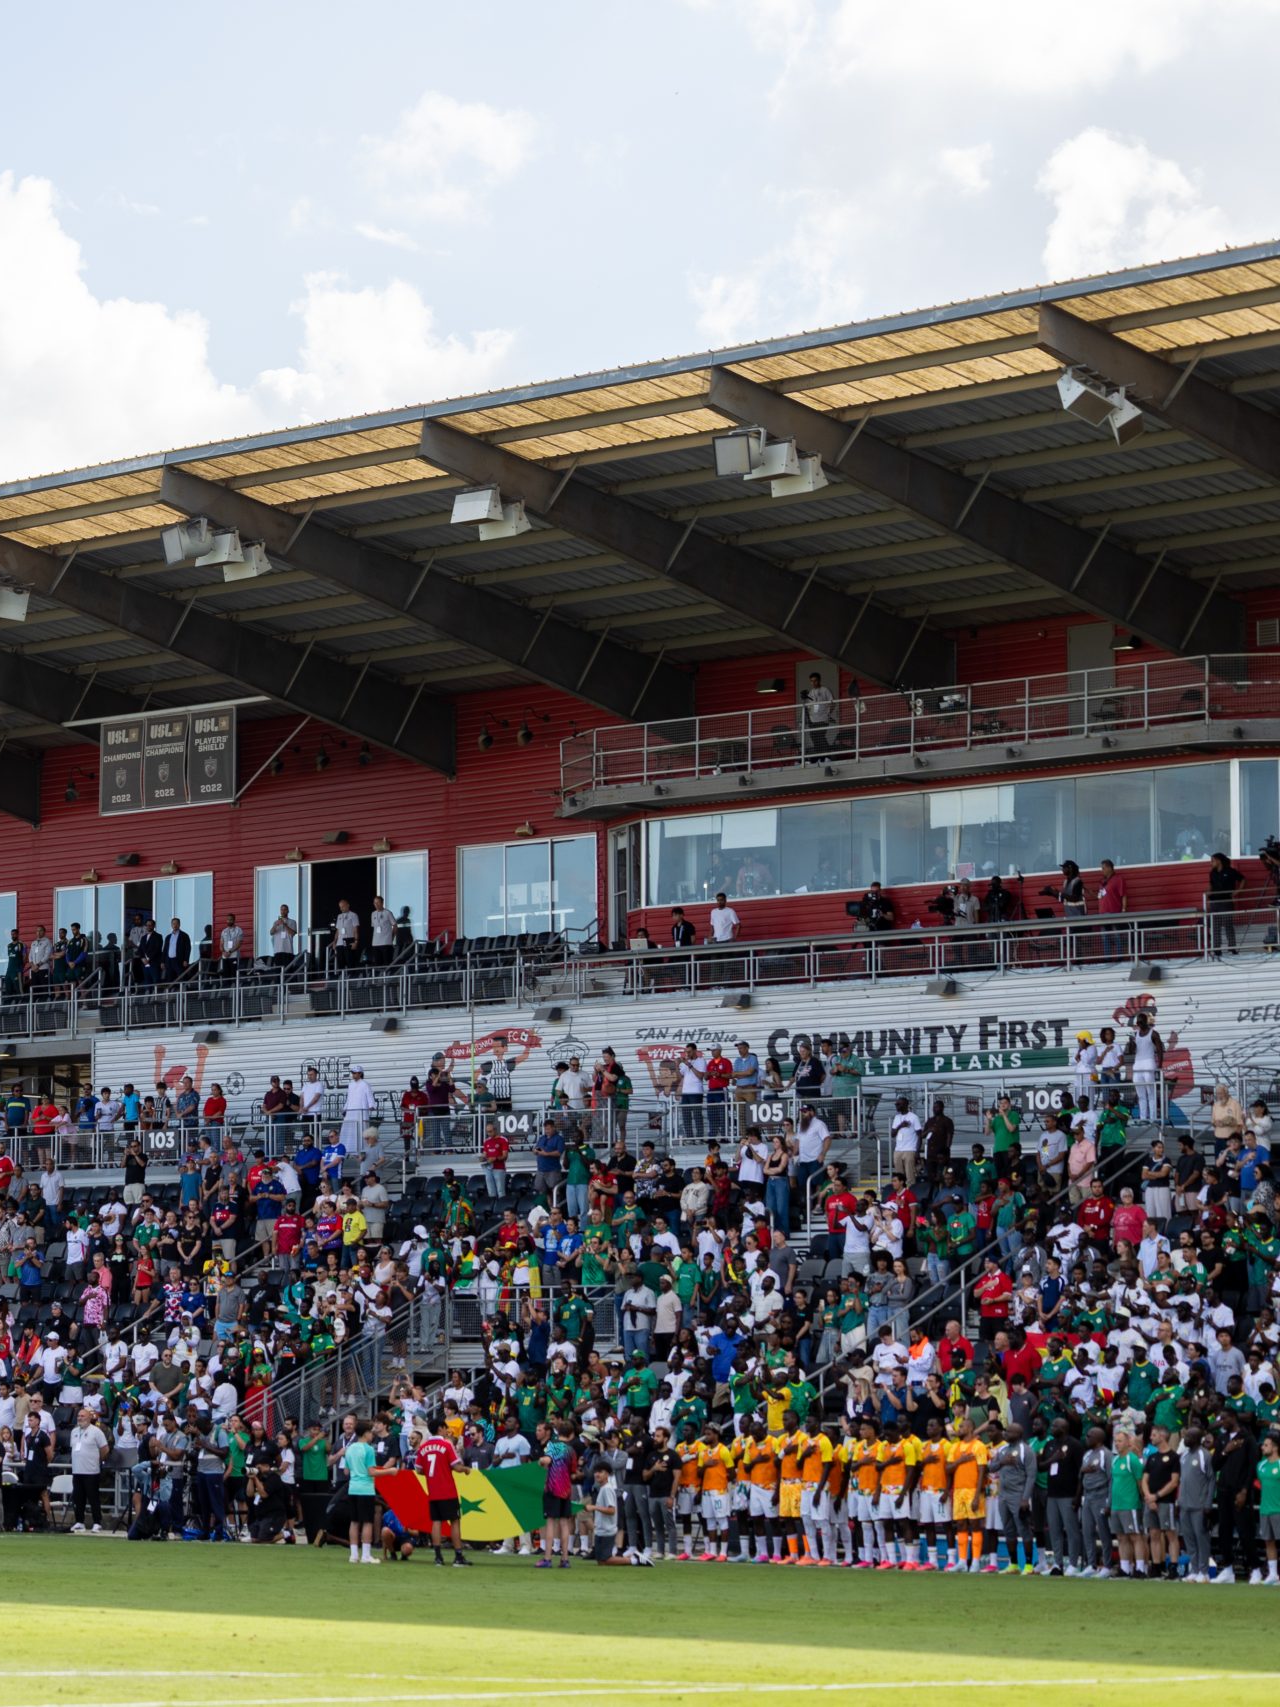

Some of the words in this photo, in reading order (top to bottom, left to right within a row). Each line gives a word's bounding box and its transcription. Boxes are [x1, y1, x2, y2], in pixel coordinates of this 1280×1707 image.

[145, 745, 184, 757] CHAMPIONS
[198, 742, 225, 753] SHIELD
[103, 751, 141, 763] CHAMPIONS
[154, 788, 175, 798] 2022
[200, 783, 222, 793] 2022
[112, 793, 131, 803] 2022
[508, 1031, 519, 1041] FC
[635, 1027, 669, 1041] SAN
[979, 1016, 1069, 1050] FIRST
[647, 1048, 681, 1060] WINS
[934, 1053, 1022, 1071] PLANS
[1026, 1090, 1063, 1110] 106
[750, 1103, 783, 1123] 105
[498, 1115, 529, 1134] 104
[149, 1132, 175, 1149] 103
[427, 1454, 436, 1477] 7
